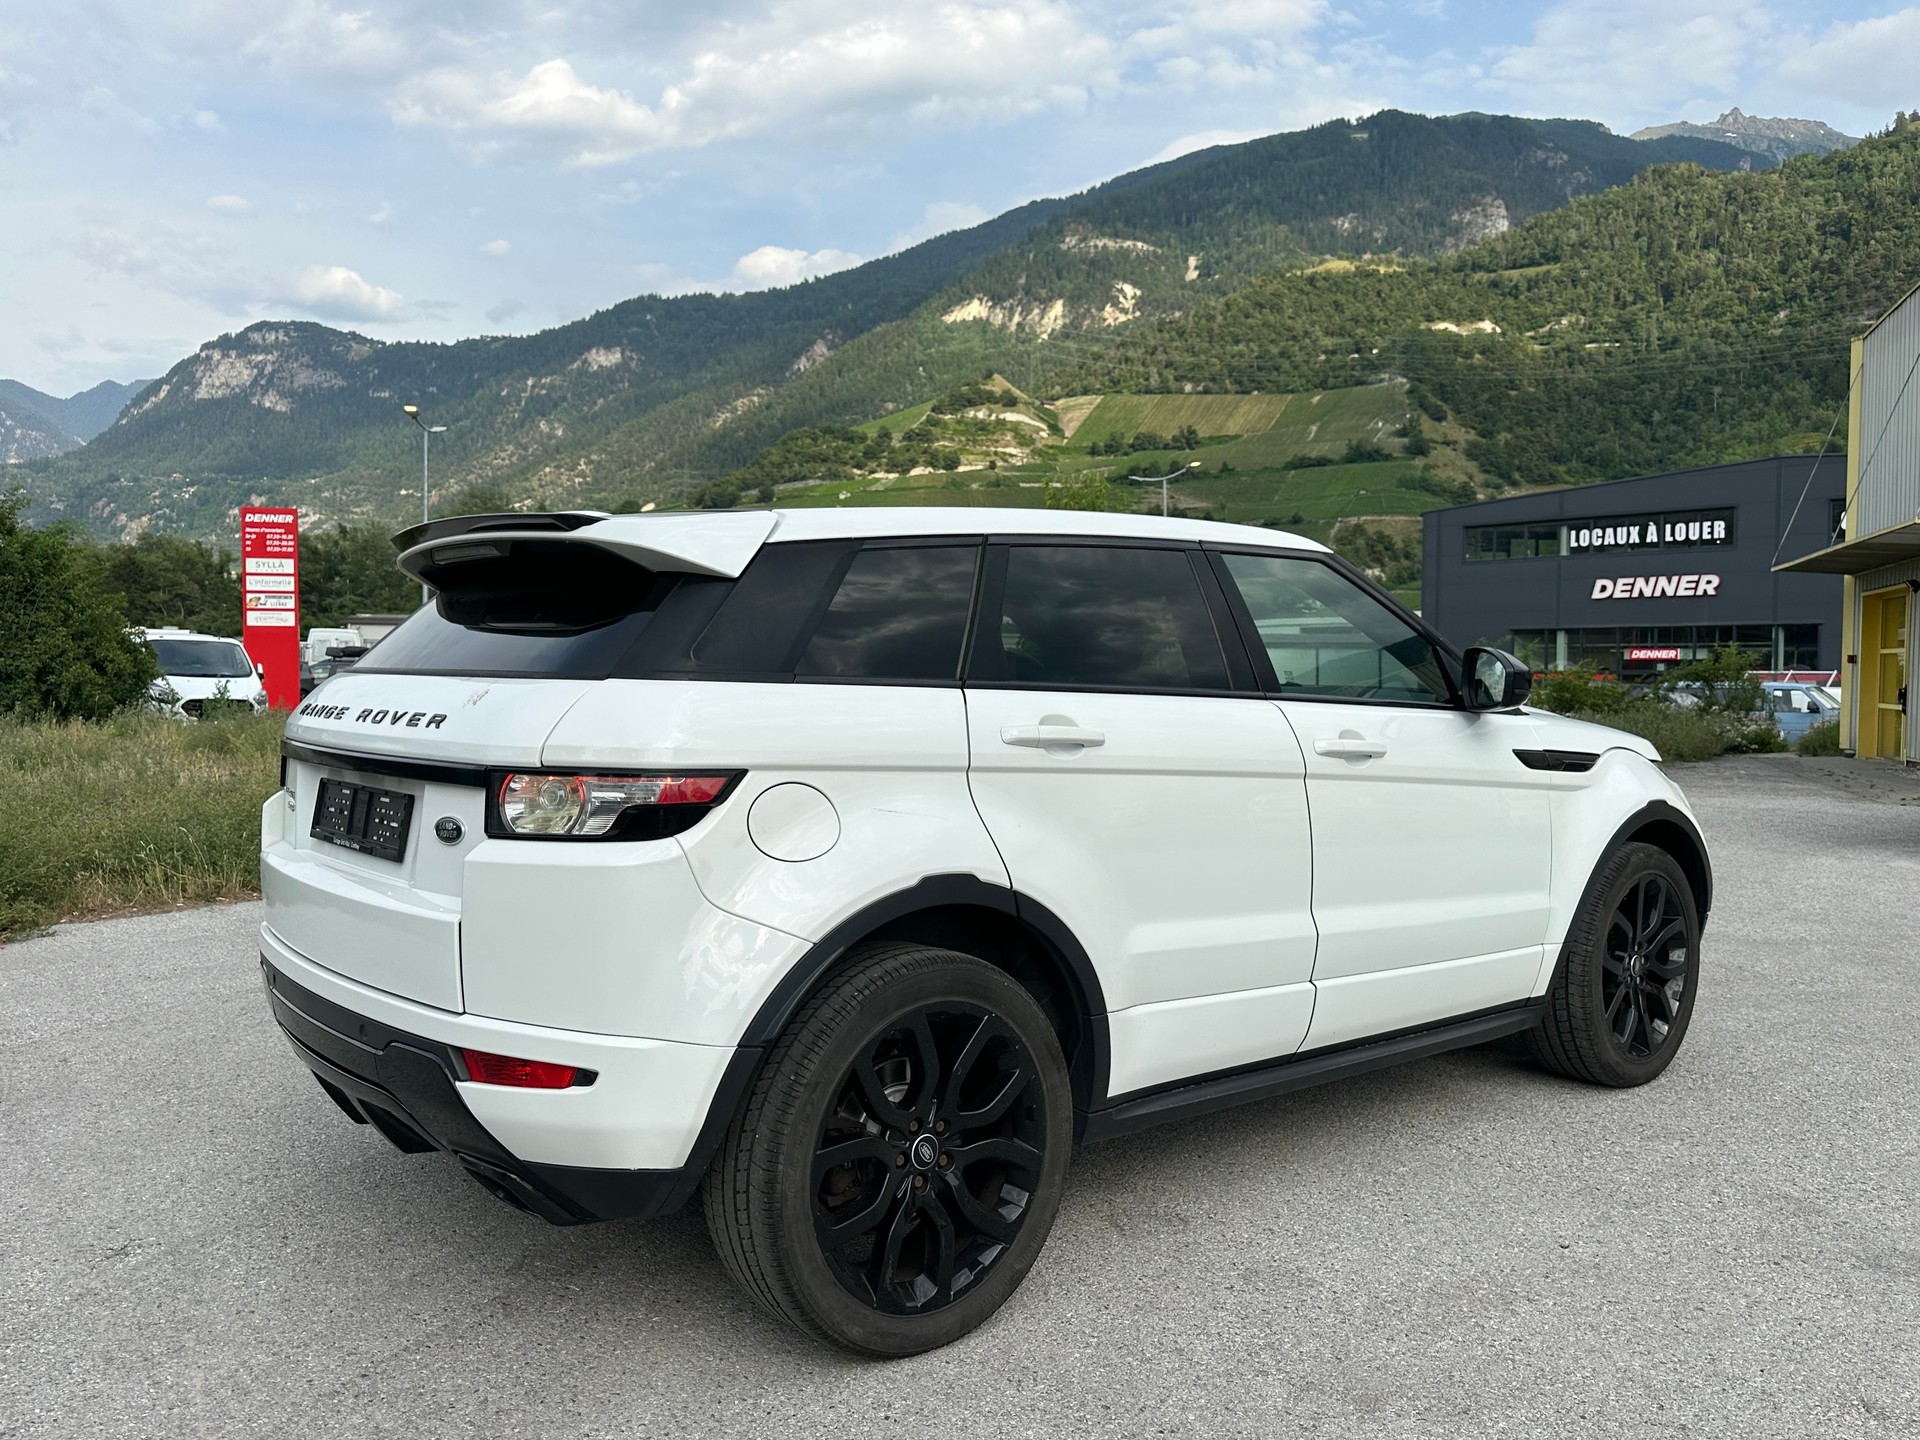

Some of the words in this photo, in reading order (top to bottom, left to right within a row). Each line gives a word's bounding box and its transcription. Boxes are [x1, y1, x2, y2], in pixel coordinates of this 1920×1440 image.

[245, 513, 294, 523] DENNER
[1570, 525, 1640, 547] LOCAUX
[1645, 521, 1658, 543] À
[1665, 520, 1726, 542] LOUER
[1591, 574, 1721, 599] DENNER
[1631, 649, 1677, 659] DENNER
[299, 702, 350, 720] RANGE
[355, 708, 448, 729] ROVER
[439, 821, 453, 830] LAND
